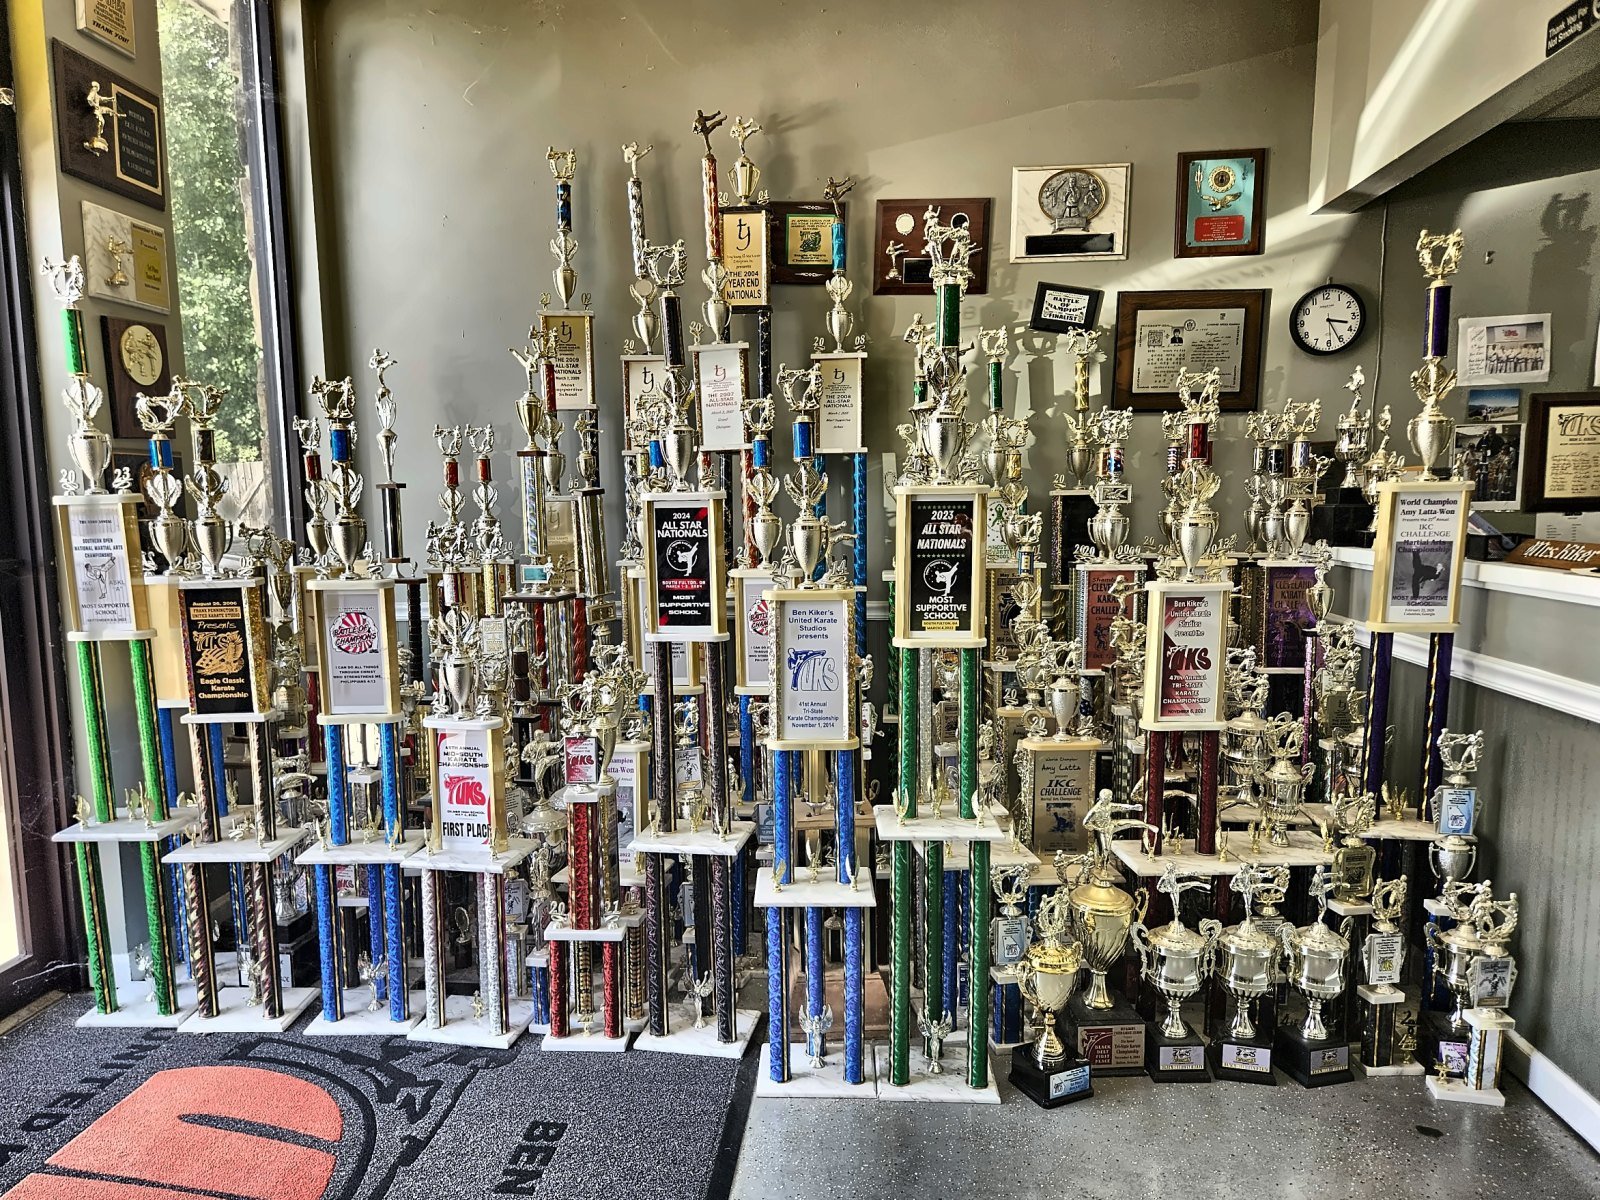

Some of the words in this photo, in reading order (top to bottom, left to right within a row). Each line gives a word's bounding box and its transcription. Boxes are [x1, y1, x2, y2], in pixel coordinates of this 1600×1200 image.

[728, 279, 745, 288] YEAR
[747, 278, 759, 287] END
[727, 290, 761, 299] NATIONALS
[1048, 313, 1077, 321] FINALIST
[624, 339, 634, 349] 20
[813, 337, 824, 346] 20
[60, 468, 76, 483] 20
[113, 466, 131, 482] 23
[650, 466, 665, 479] 20
[1054, 473, 1065, 484] 20
[931, 510, 954, 520] 2023
[662, 521, 678, 529] ALL
[922, 524, 937, 534] ALL
[939, 524, 962, 534] STAR
[657, 529, 708, 538] NATIONALS
[917, 538, 966, 549] NATIONALS
[1144, 536, 1155, 546] 20
[314, 555, 328, 567] 20
[333, 628, 356, 637] BATTLE
[335, 632, 376, 646] CHAMPIONS
[995, 646, 1007, 656] 20
[1003, 688, 1017, 699] 20
[628, 720, 641, 732] 22
[1031, 717, 1046, 729] 20
[1042, 764, 1055, 774] Amy
[1040, 788, 1082, 796] CHALLENGE
[442, 822, 464, 836] FIRST
[549, 901, 565, 915] 20
[492, 1120, 568, 1196] BEN
